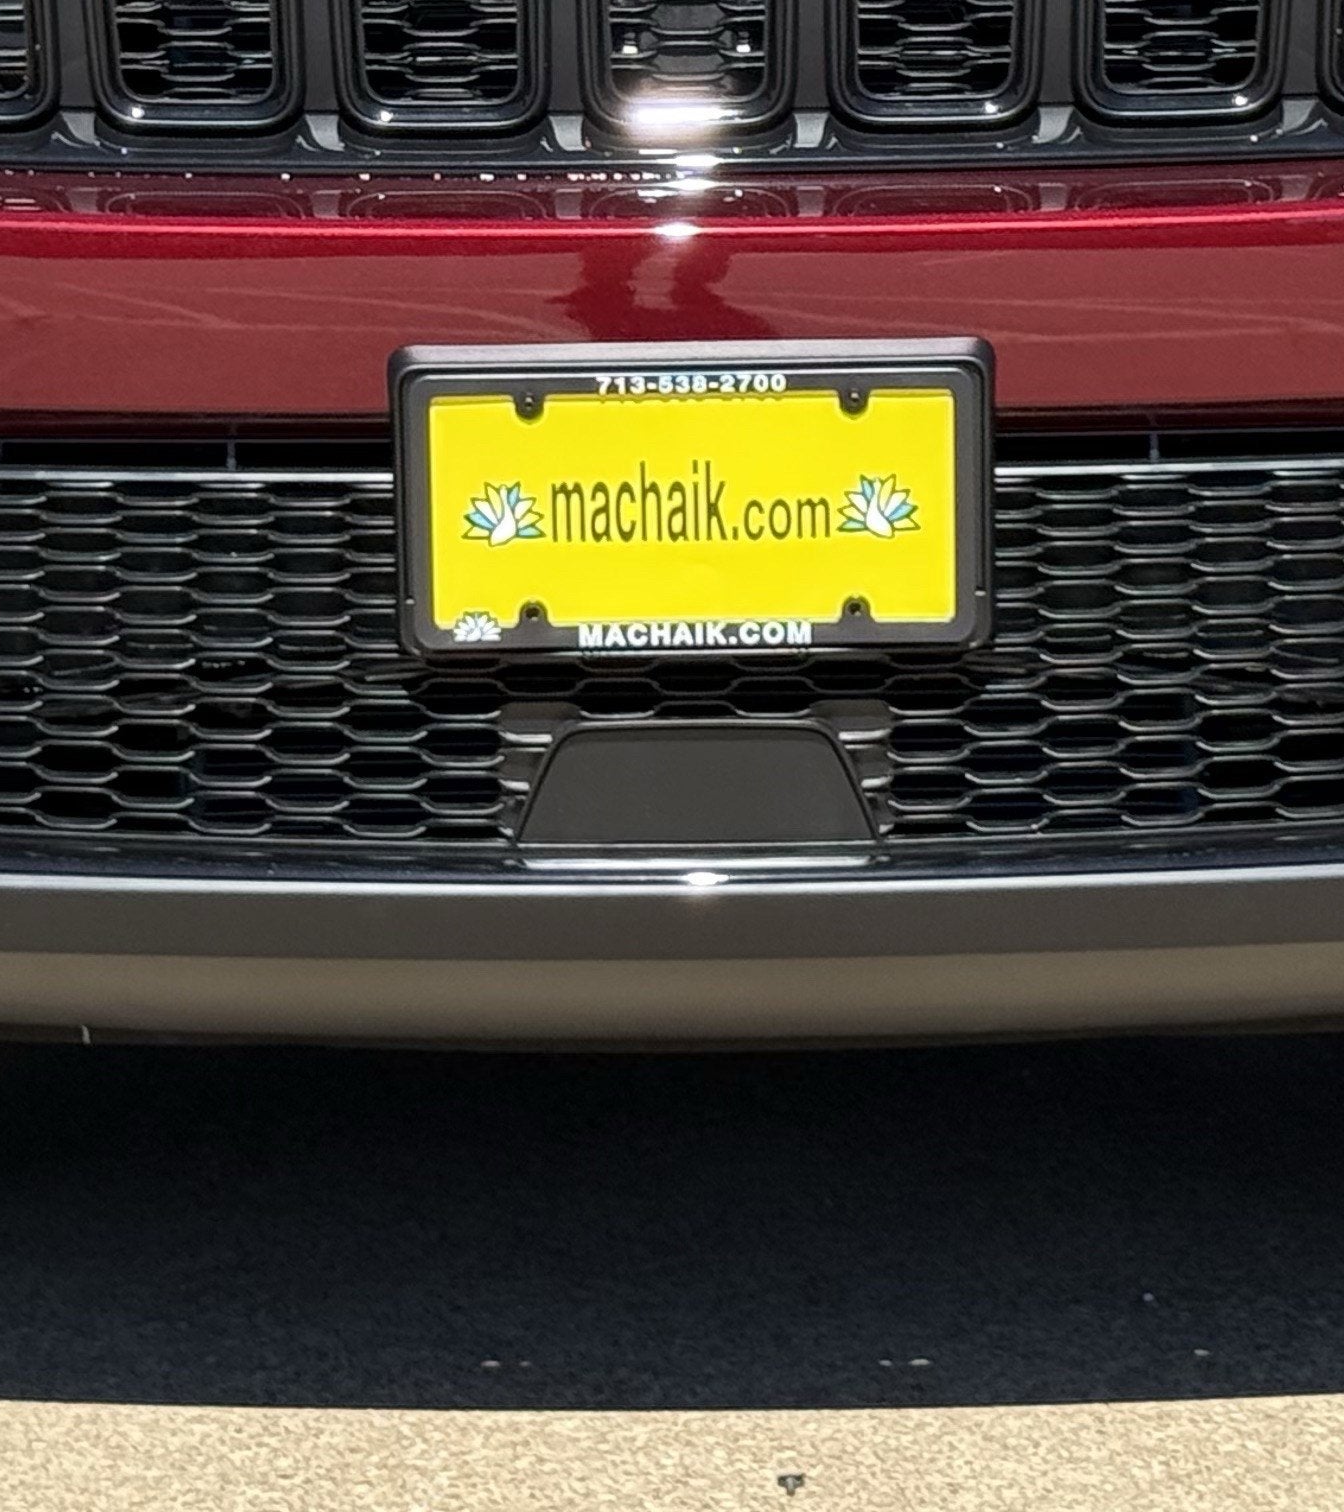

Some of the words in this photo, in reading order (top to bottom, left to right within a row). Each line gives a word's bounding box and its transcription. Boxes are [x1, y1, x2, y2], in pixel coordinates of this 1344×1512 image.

[595, 370, 787, 396] 713-538-2700
[551, 460, 832, 543] machaik.com
[578, 620, 813, 648] MACHAIK.COM
